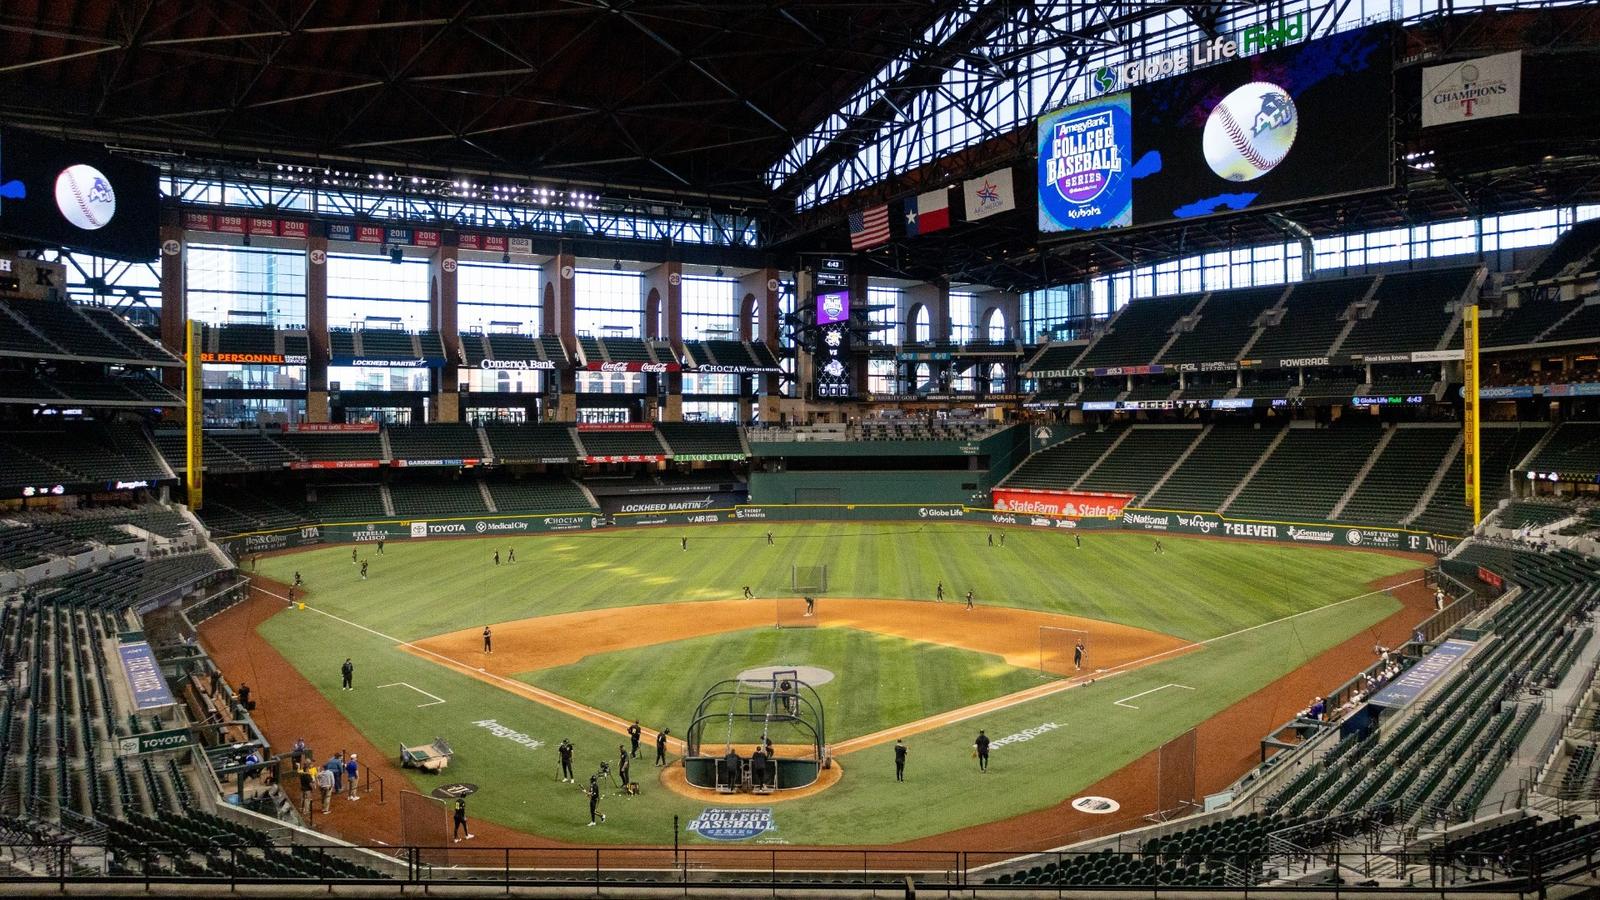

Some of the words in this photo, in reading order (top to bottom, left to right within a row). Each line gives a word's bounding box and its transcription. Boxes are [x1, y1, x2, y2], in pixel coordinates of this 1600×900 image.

[1122, 54, 1188, 84] Globe
[1193, 36, 1237, 65] Life
[1243, 13, 1303, 53] Field
[1433, 83, 1507, 104] CHAMPIONS
[1052, 126, 1114, 160] COLLEGE
[1047, 147, 1121, 184] BASEBALL
[1065, 173, 1102, 187] SERIES
[1068, 206, 1102, 218] Kubota
[221, 217, 241, 225] 1998
[253, 219, 272, 228] 1999
[285, 221, 305, 230] 2010
[331, 225, 350, 233] 2010
[362, 227, 379, 235] 2011
[390, 229, 406, 237] 2011
[419, 232, 436, 240] 2012
[164, 243, 178, 253] 42
[312, 253, 325, 262] 34
[444, 260, 456, 269] 26
[218, 353, 284, 363] PERSONNEL
[1279, 357, 1329, 367] POWERADE
[529, 360, 555, 369] Bank
[601, 361, 629, 372] Coca-Cola
[641, 362, 668, 373] Coca-Cola
[1180, 363, 1198, 371] PGL
[1033, 370, 1045, 378] UT
[1047, 368, 1086, 378] DALLAS
[680, 454, 707, 462] LUXOR
[708, 453, 745, 461] STAFFING
[621, 503, 666, 513] LOCKHEED
[668, 502, 701, 512] MARTIN
[1009, 499, 1034, 513] State
[1033, 501, 1059, 515] Farm
[1079, 503, 1105, 516] State
[928, 508, 949, 517] Globe
[950, 508, 963, 517] Life
[992, 514, 1016, 524] Kubota
[1133, 514, 1169, 525] National
[1189, 515, 1219, 533] Kroger
[429, 523, 466, 533] TOYOTA
[487, 522, 514, 530] Medical
[514, 522, 528, 530] City
[301, 527, 319, 539] UTA
[1299, 528, 1335, 538] Germania
[143, 734, 188, 748] TOYOTA
[700, 812, 770, 821] COLLEGE
[689, 820, 775, 830] BASEBALL
